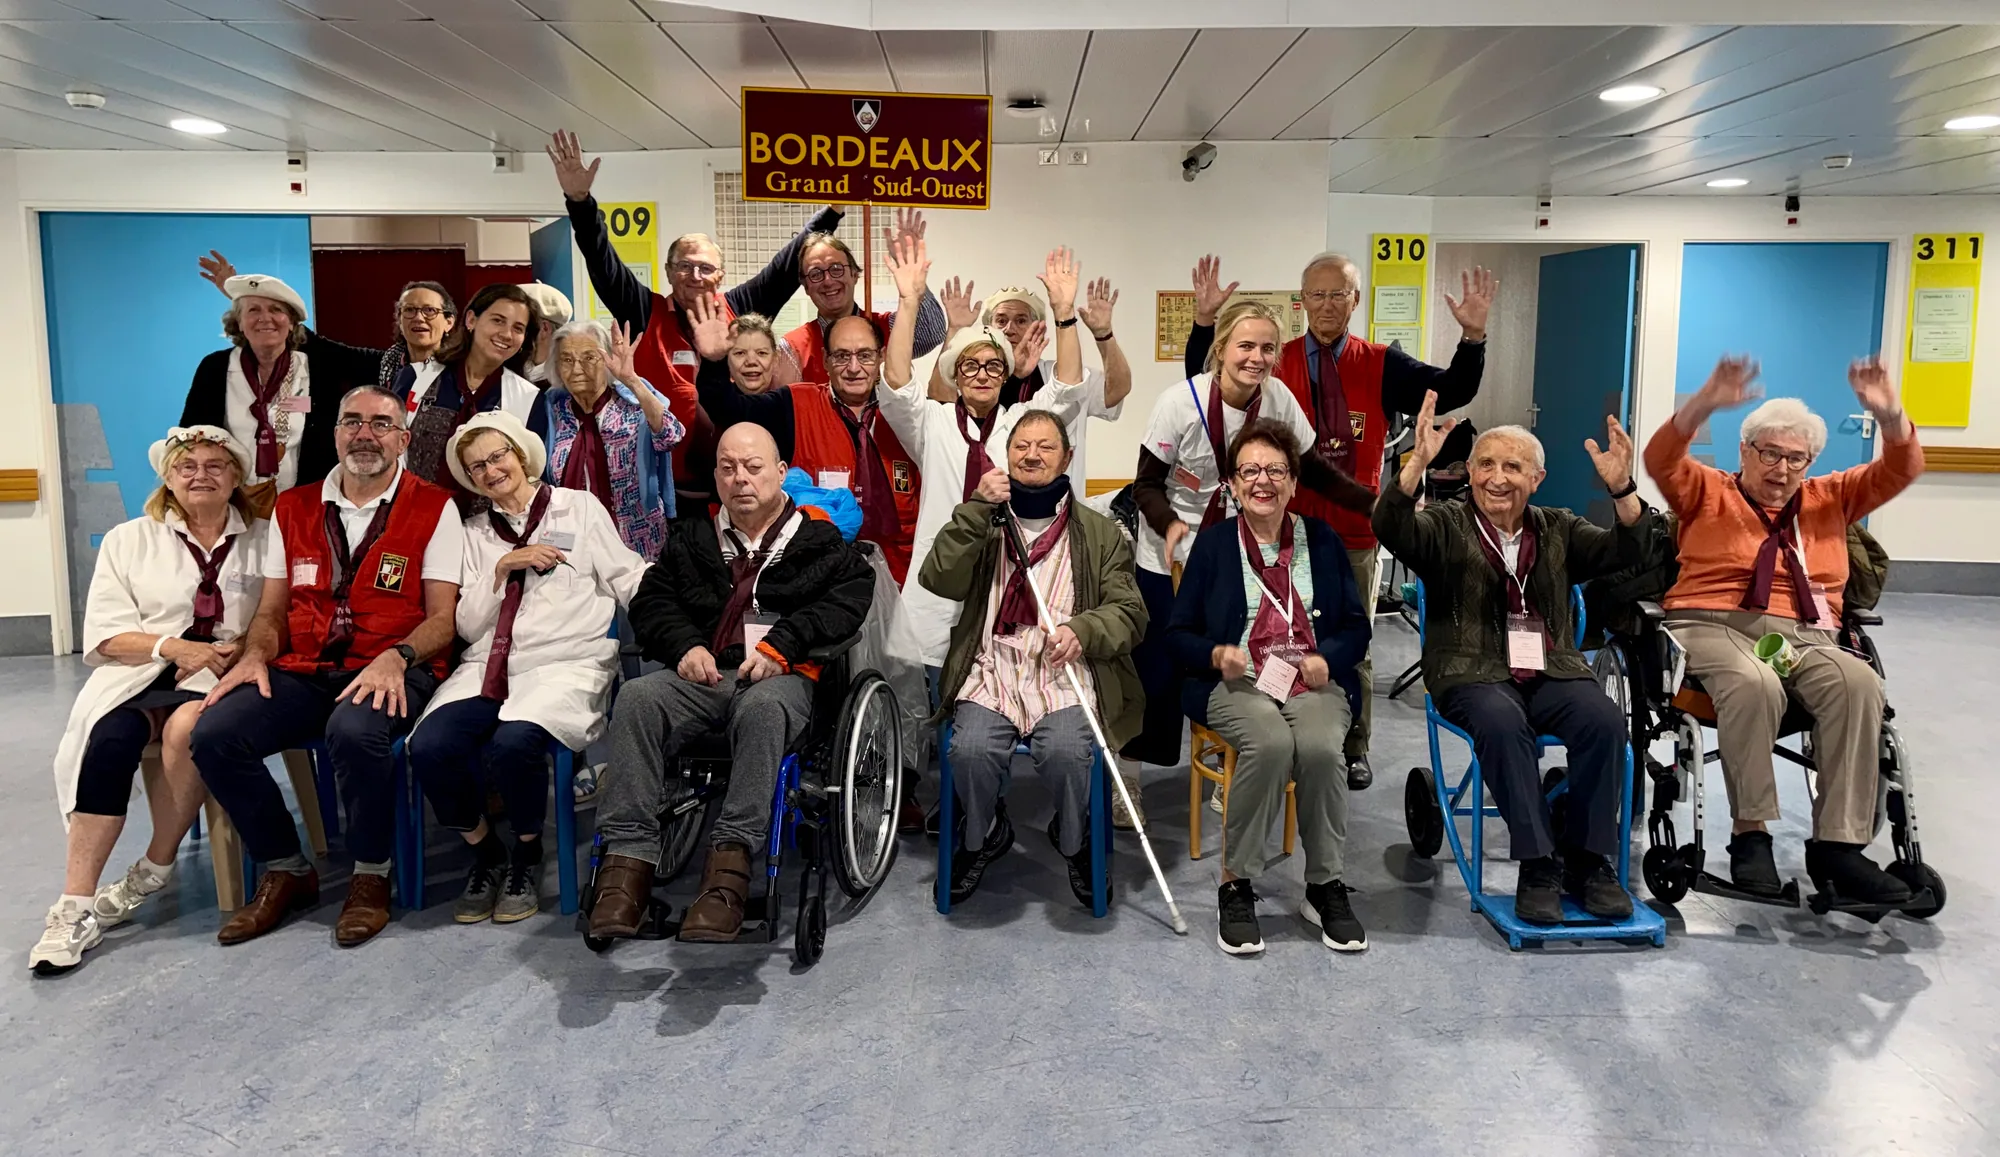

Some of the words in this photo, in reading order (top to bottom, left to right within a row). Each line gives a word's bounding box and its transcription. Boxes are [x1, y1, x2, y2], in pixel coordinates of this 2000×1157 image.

[750, 131, 982, 172] BORDEAUX
[765, 171, 850, 194] Grand
[873, 174, 985, 199] Sud-Ouest
[1377, 238, 1425, 261] 310
[1917, 237, 1980, 260] 311
